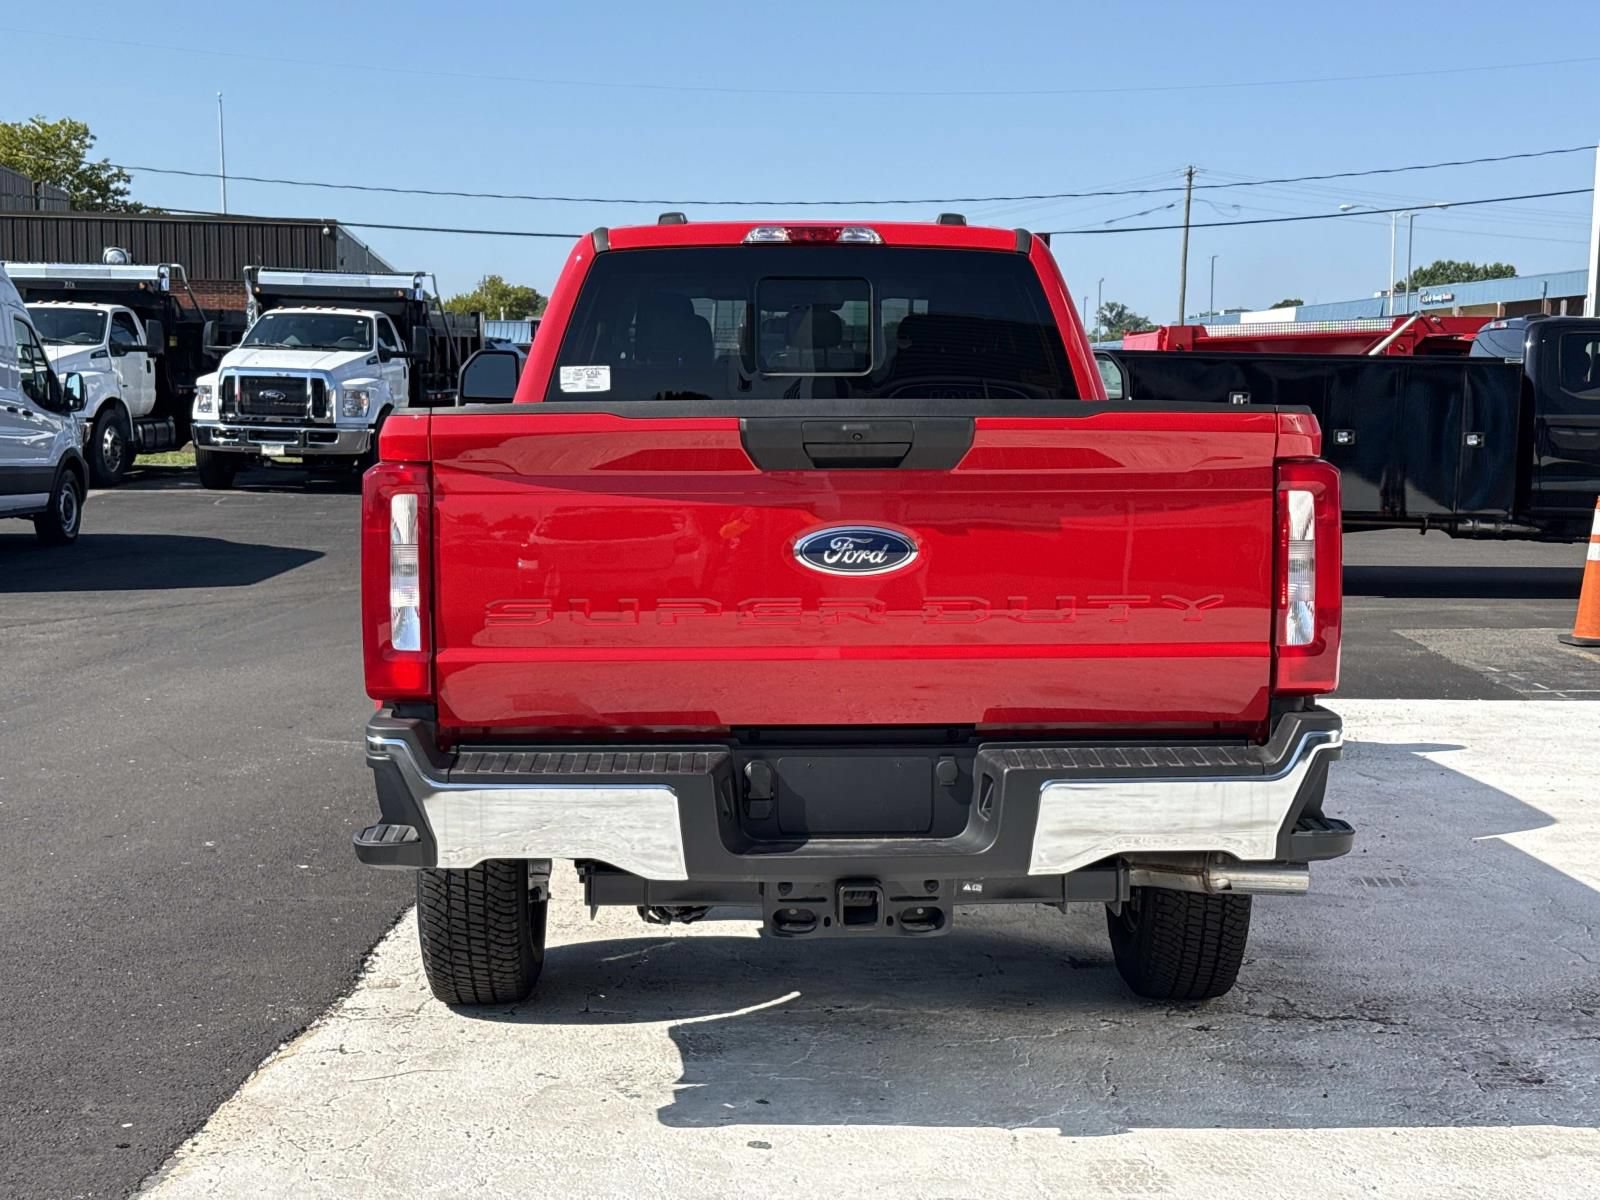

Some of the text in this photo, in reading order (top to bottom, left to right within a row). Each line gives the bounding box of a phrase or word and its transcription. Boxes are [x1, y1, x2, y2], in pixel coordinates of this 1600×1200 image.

[823, 536, 889, 564] Ford
[485, 595, 1225, 626] SUPER DUTY
